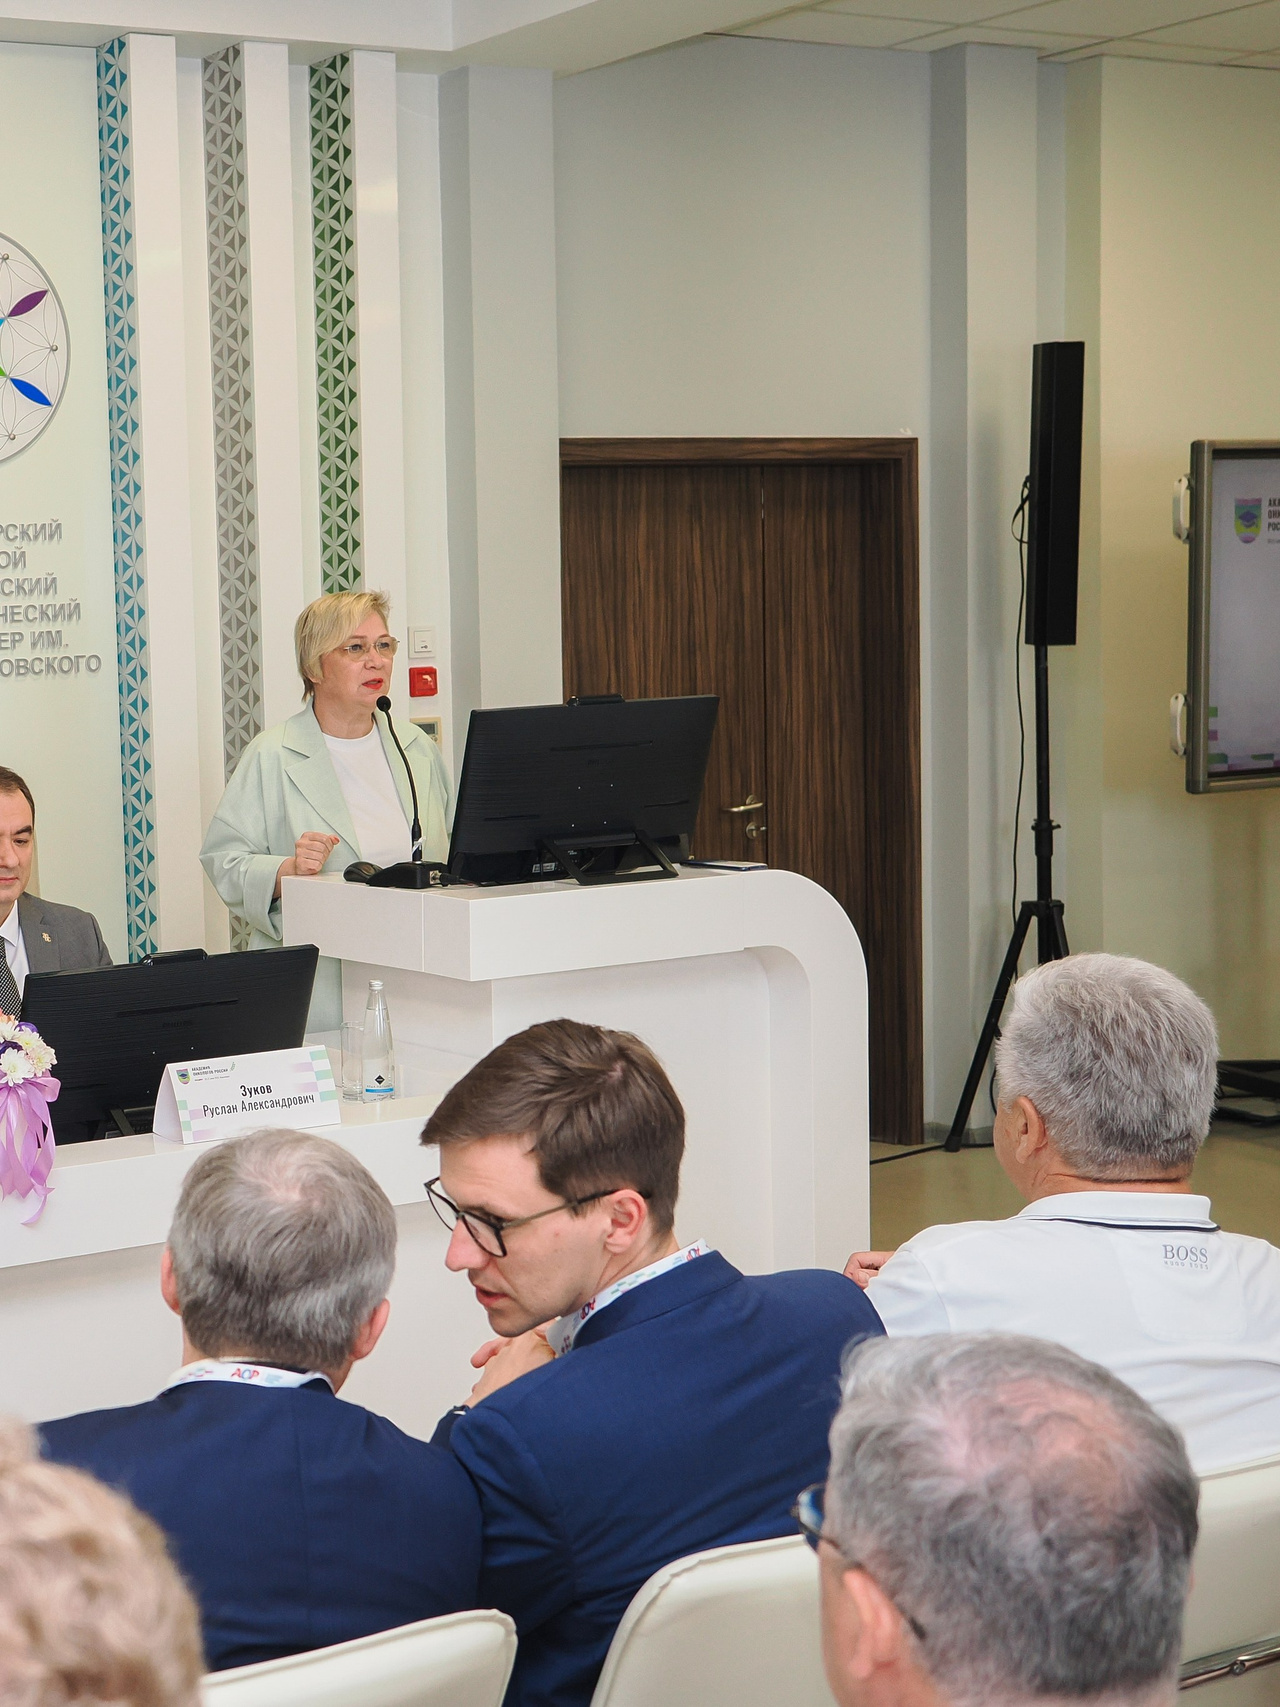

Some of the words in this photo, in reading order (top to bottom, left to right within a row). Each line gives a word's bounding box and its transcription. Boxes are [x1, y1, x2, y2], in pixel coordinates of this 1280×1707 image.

[30, 629, 69, 650] ИМ.
[240, 1084, 273, 1100] Зуков
[202, 1103, 238, 1118] Руслан
[241, 1094, 315, 1113] Александрович
[1162, 1244, 1208, 1264] BOSS
